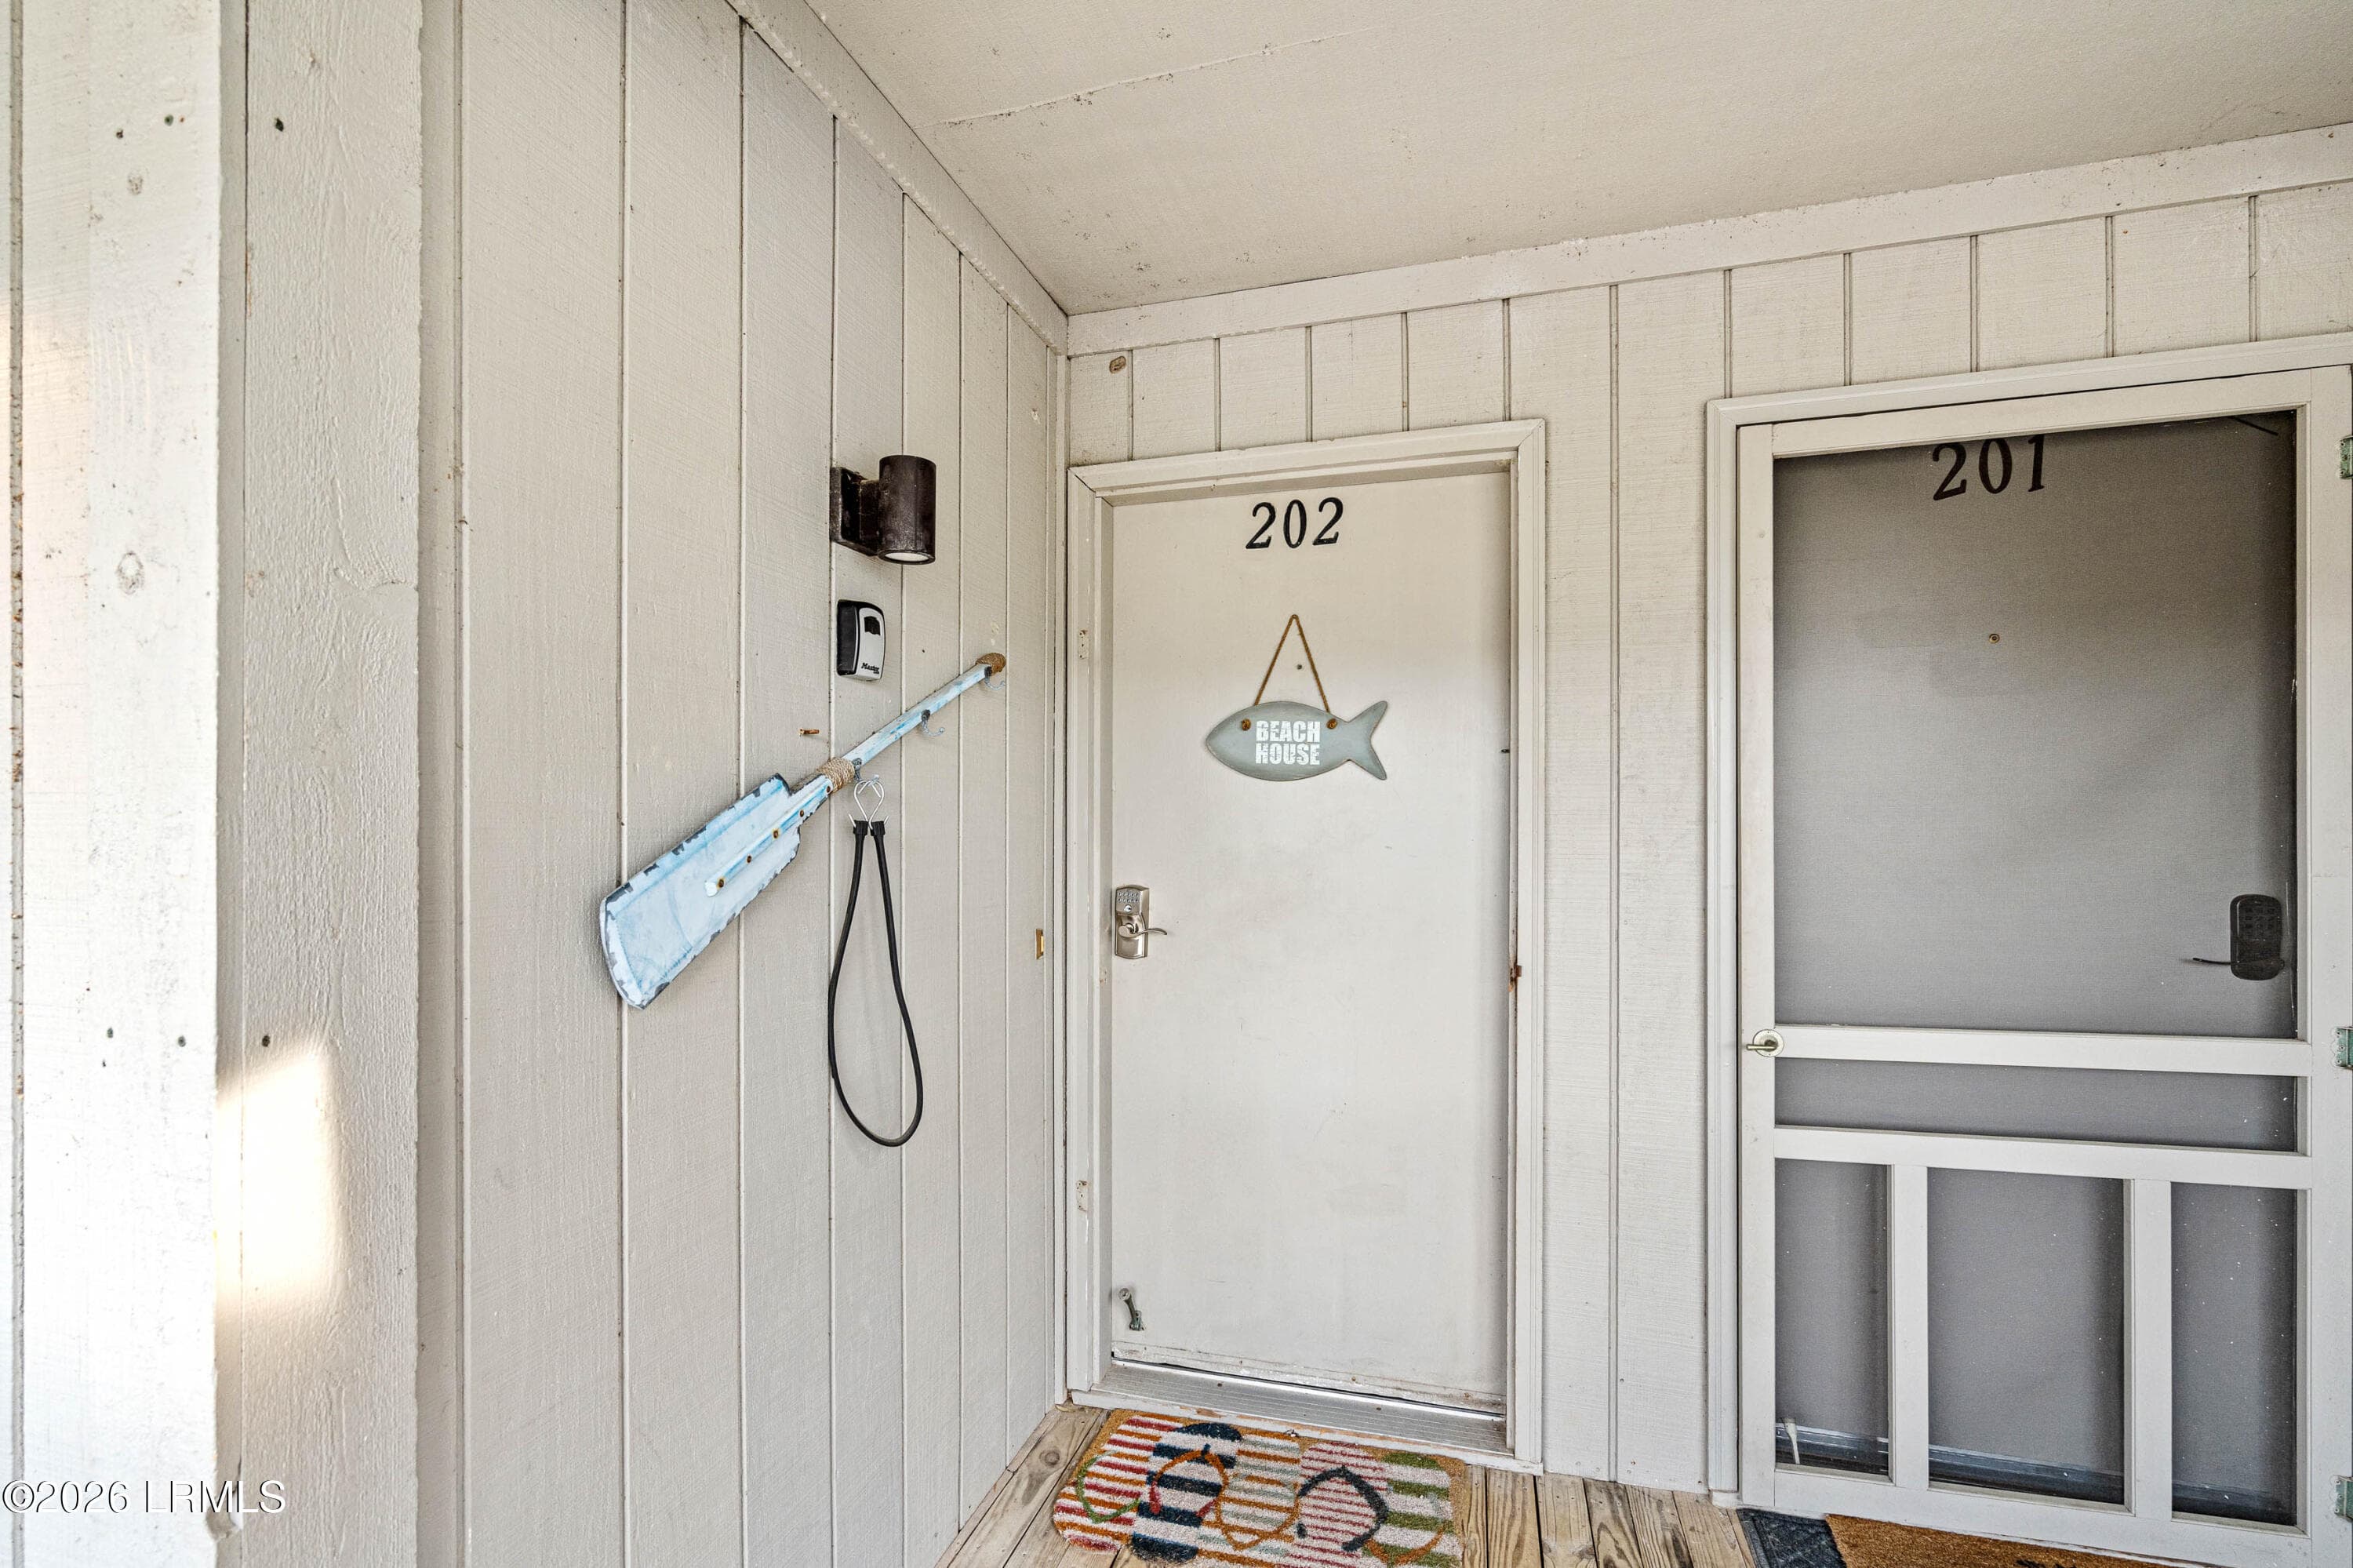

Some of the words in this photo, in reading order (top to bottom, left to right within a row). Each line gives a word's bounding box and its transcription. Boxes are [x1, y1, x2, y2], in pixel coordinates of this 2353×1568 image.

[1932, 434, 2045, 500] 201
[1246, 497, 1344, 549] 202
[1256, 720, 1321, 743] BEACH
[1255, 743, 1320, 766] HOUSE
